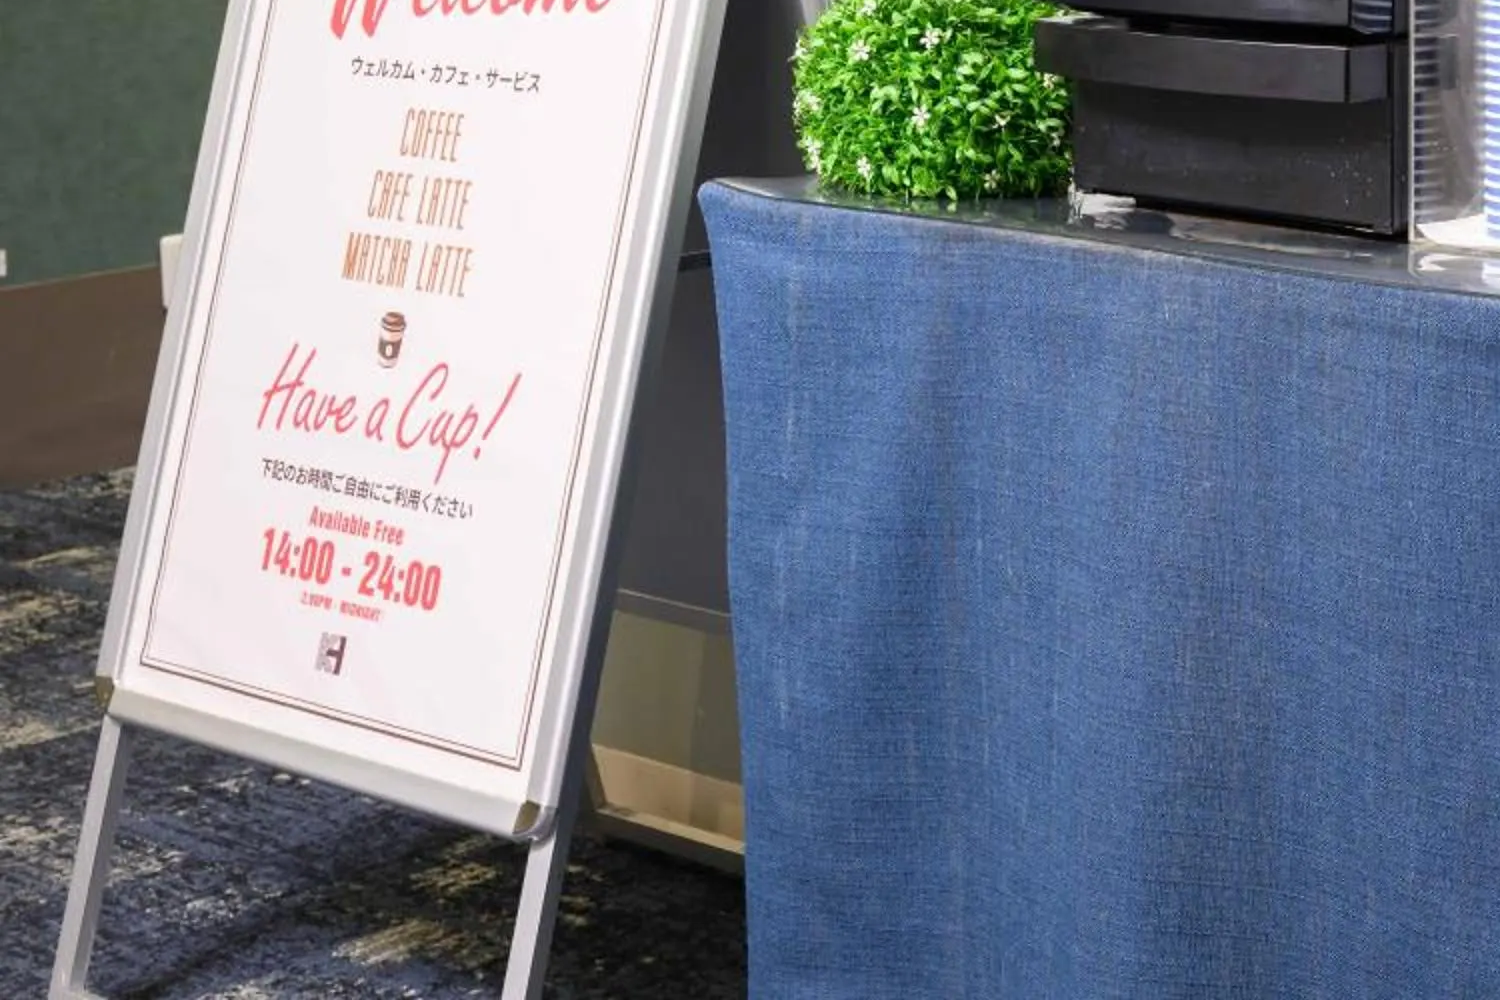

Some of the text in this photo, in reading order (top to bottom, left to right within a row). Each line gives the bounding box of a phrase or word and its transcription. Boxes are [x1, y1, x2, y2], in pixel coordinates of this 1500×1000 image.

[350, 55, 542, 94] ウェルカム・カフェ・サービス
[399, 106, 465, 163] COFFEE
[367, 169, 473, 230] CAFE LATTE
[341, 231, 473, 298] MATCHA LATTE
[257, 343, 522, 486] Have a Cup!
[308, 505, 405, 545] Available Free
[261, 527, 335, 585] 14:00
[357, 551, 442, 611] 24:00
